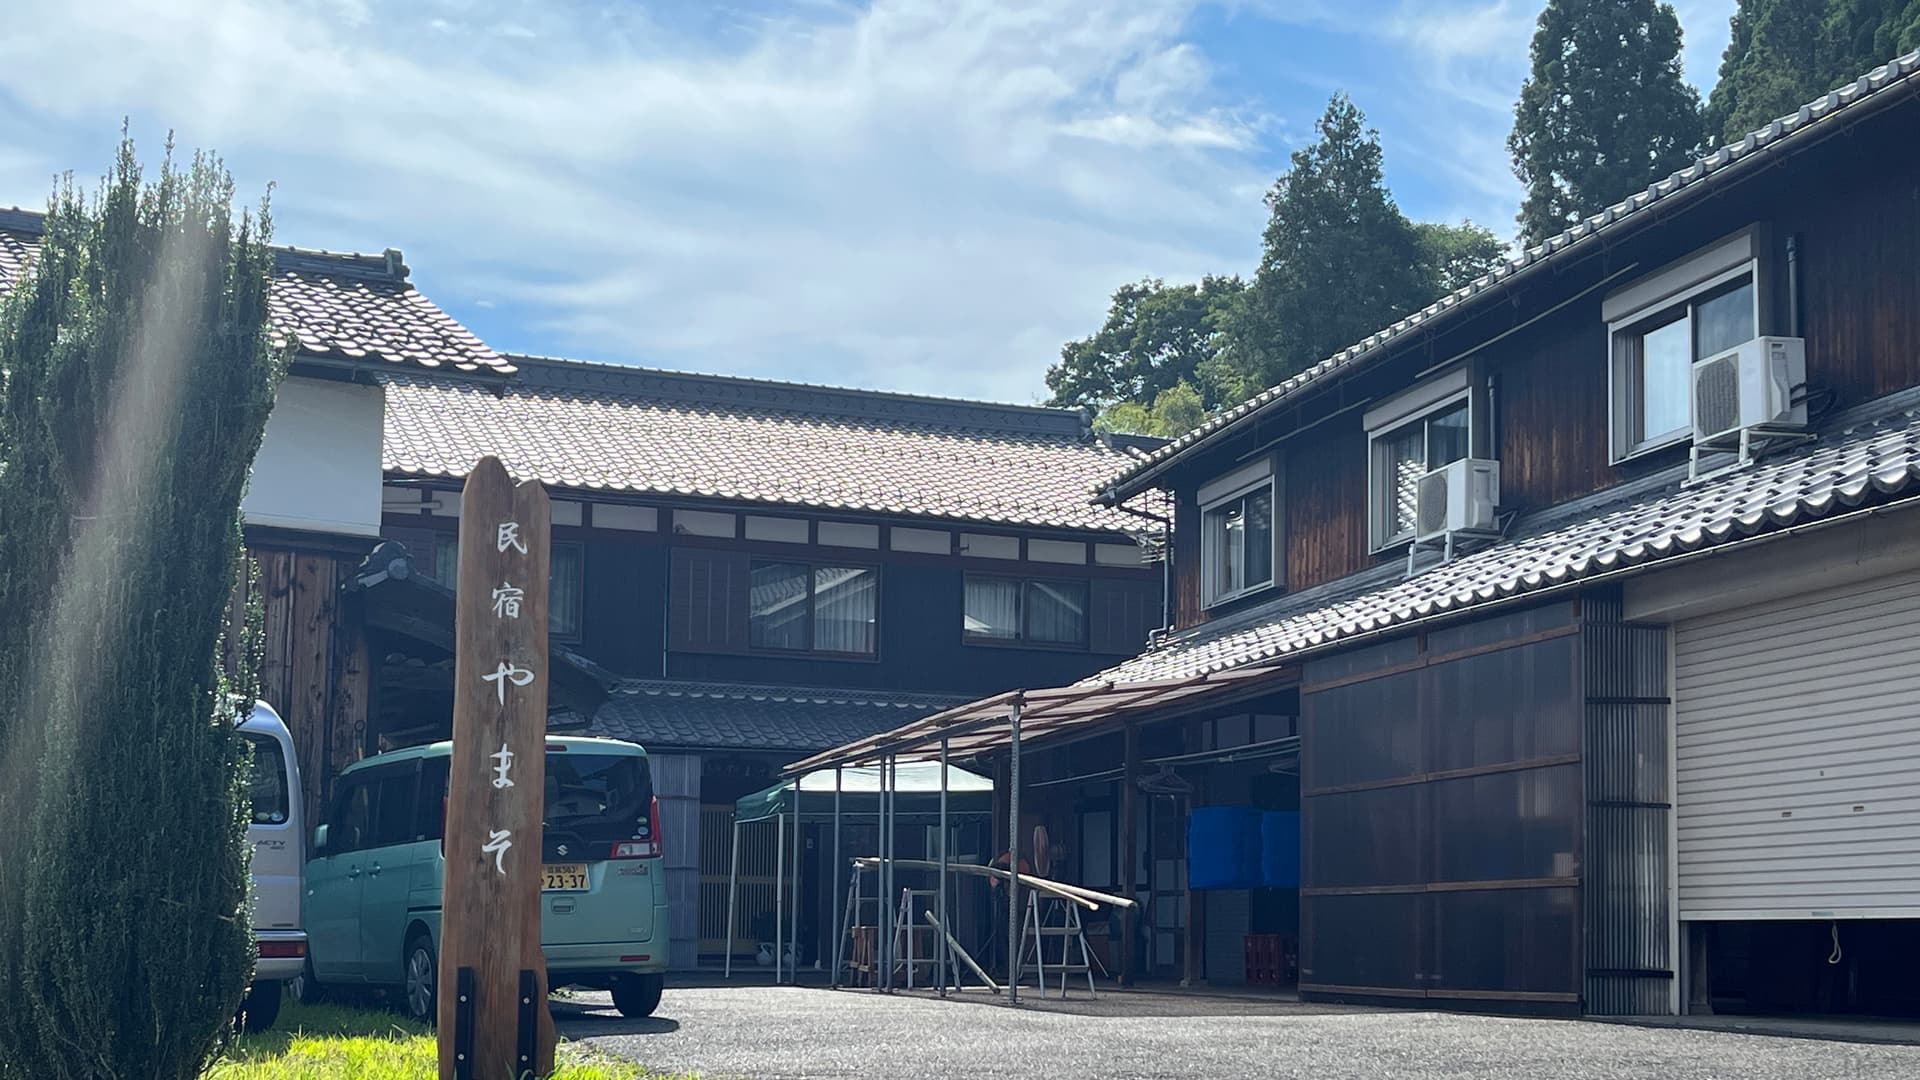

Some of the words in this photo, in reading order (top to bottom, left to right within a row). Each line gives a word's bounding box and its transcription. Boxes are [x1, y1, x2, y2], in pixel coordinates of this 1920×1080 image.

[482, 522, 535, 875] 民宿やまそ
[547, 874, 585, 889] 23-37
